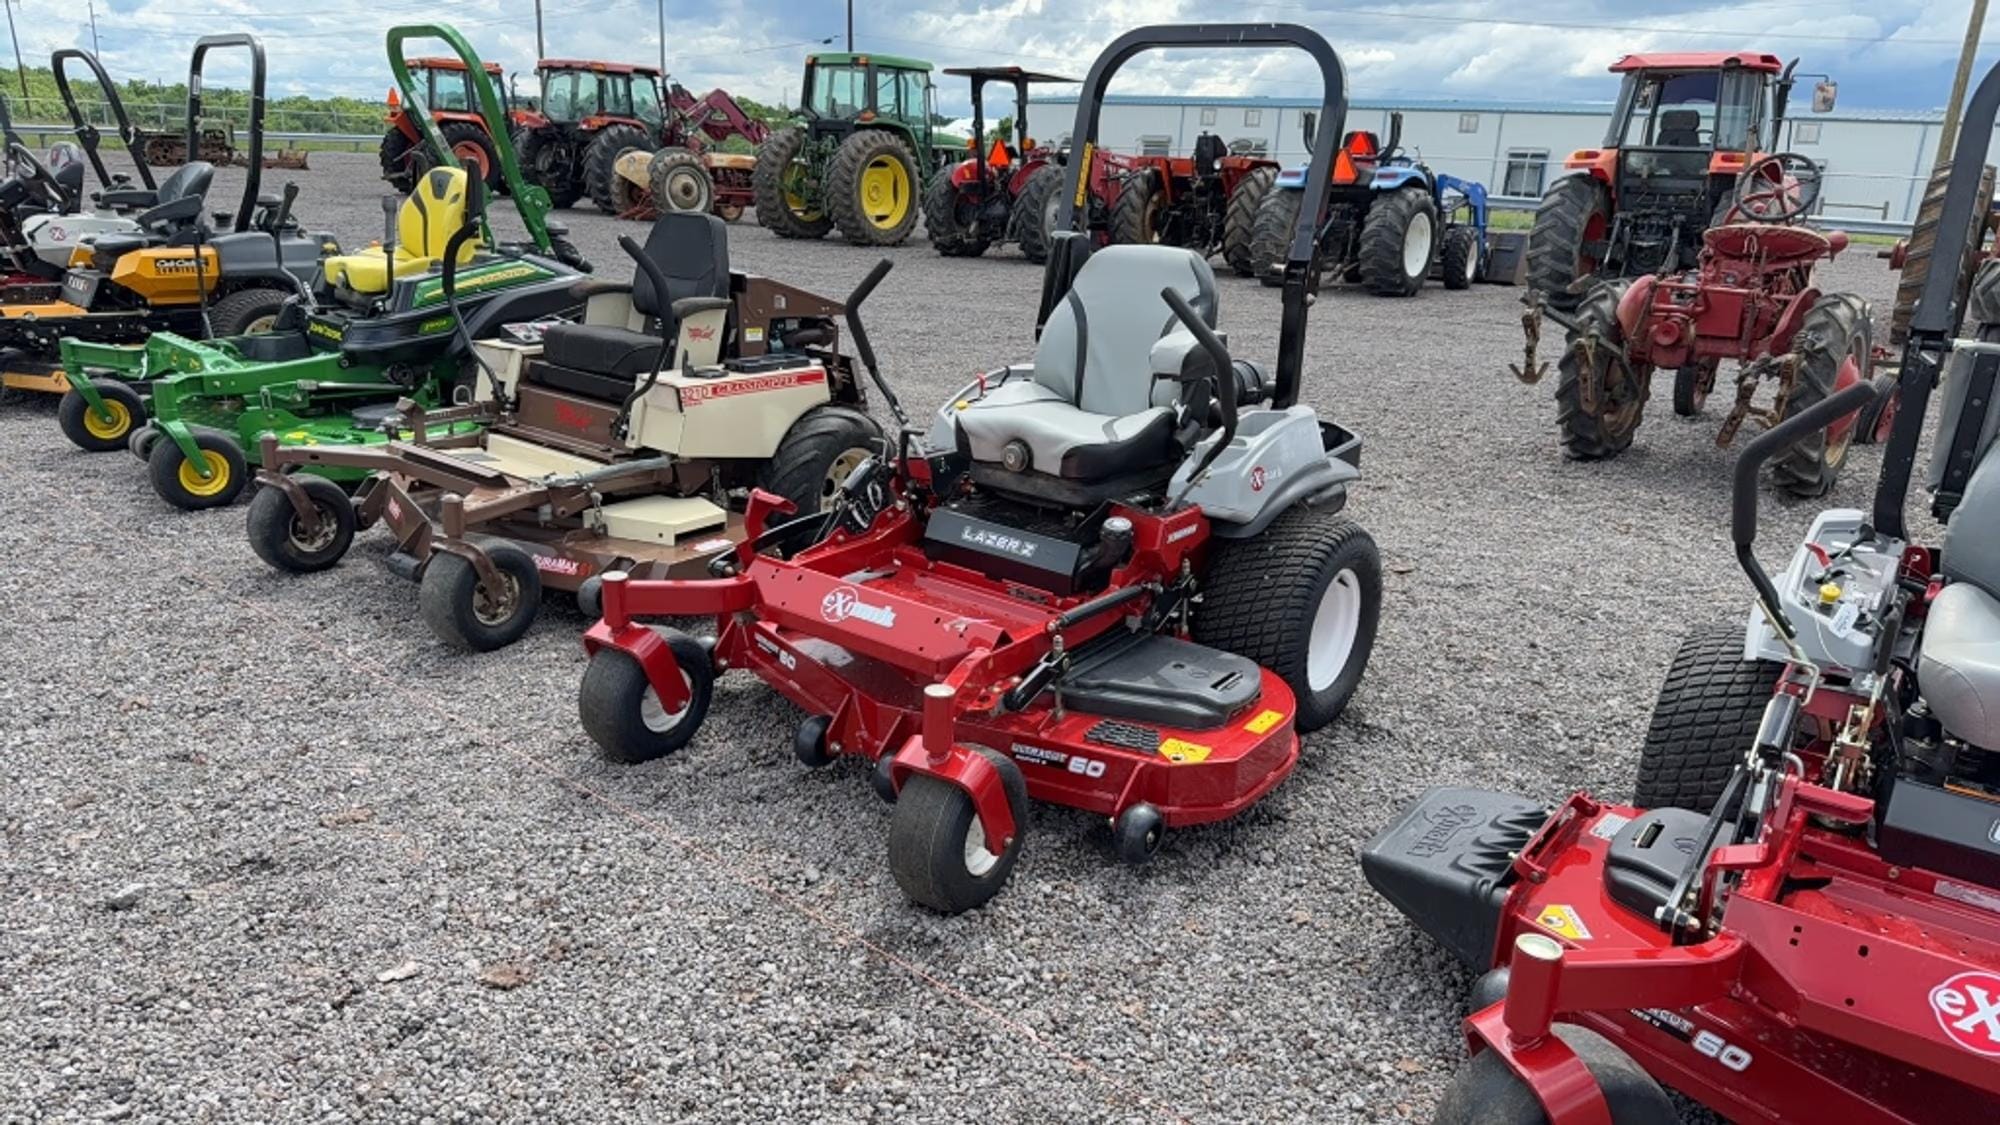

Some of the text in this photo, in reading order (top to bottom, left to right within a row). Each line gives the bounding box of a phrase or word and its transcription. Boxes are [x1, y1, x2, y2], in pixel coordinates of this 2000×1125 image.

[961, 526, 1038, 557] LAZER Z
[1068, 756, 1106, 778] 60
[1692, 1029, 1753, 1072] 60
